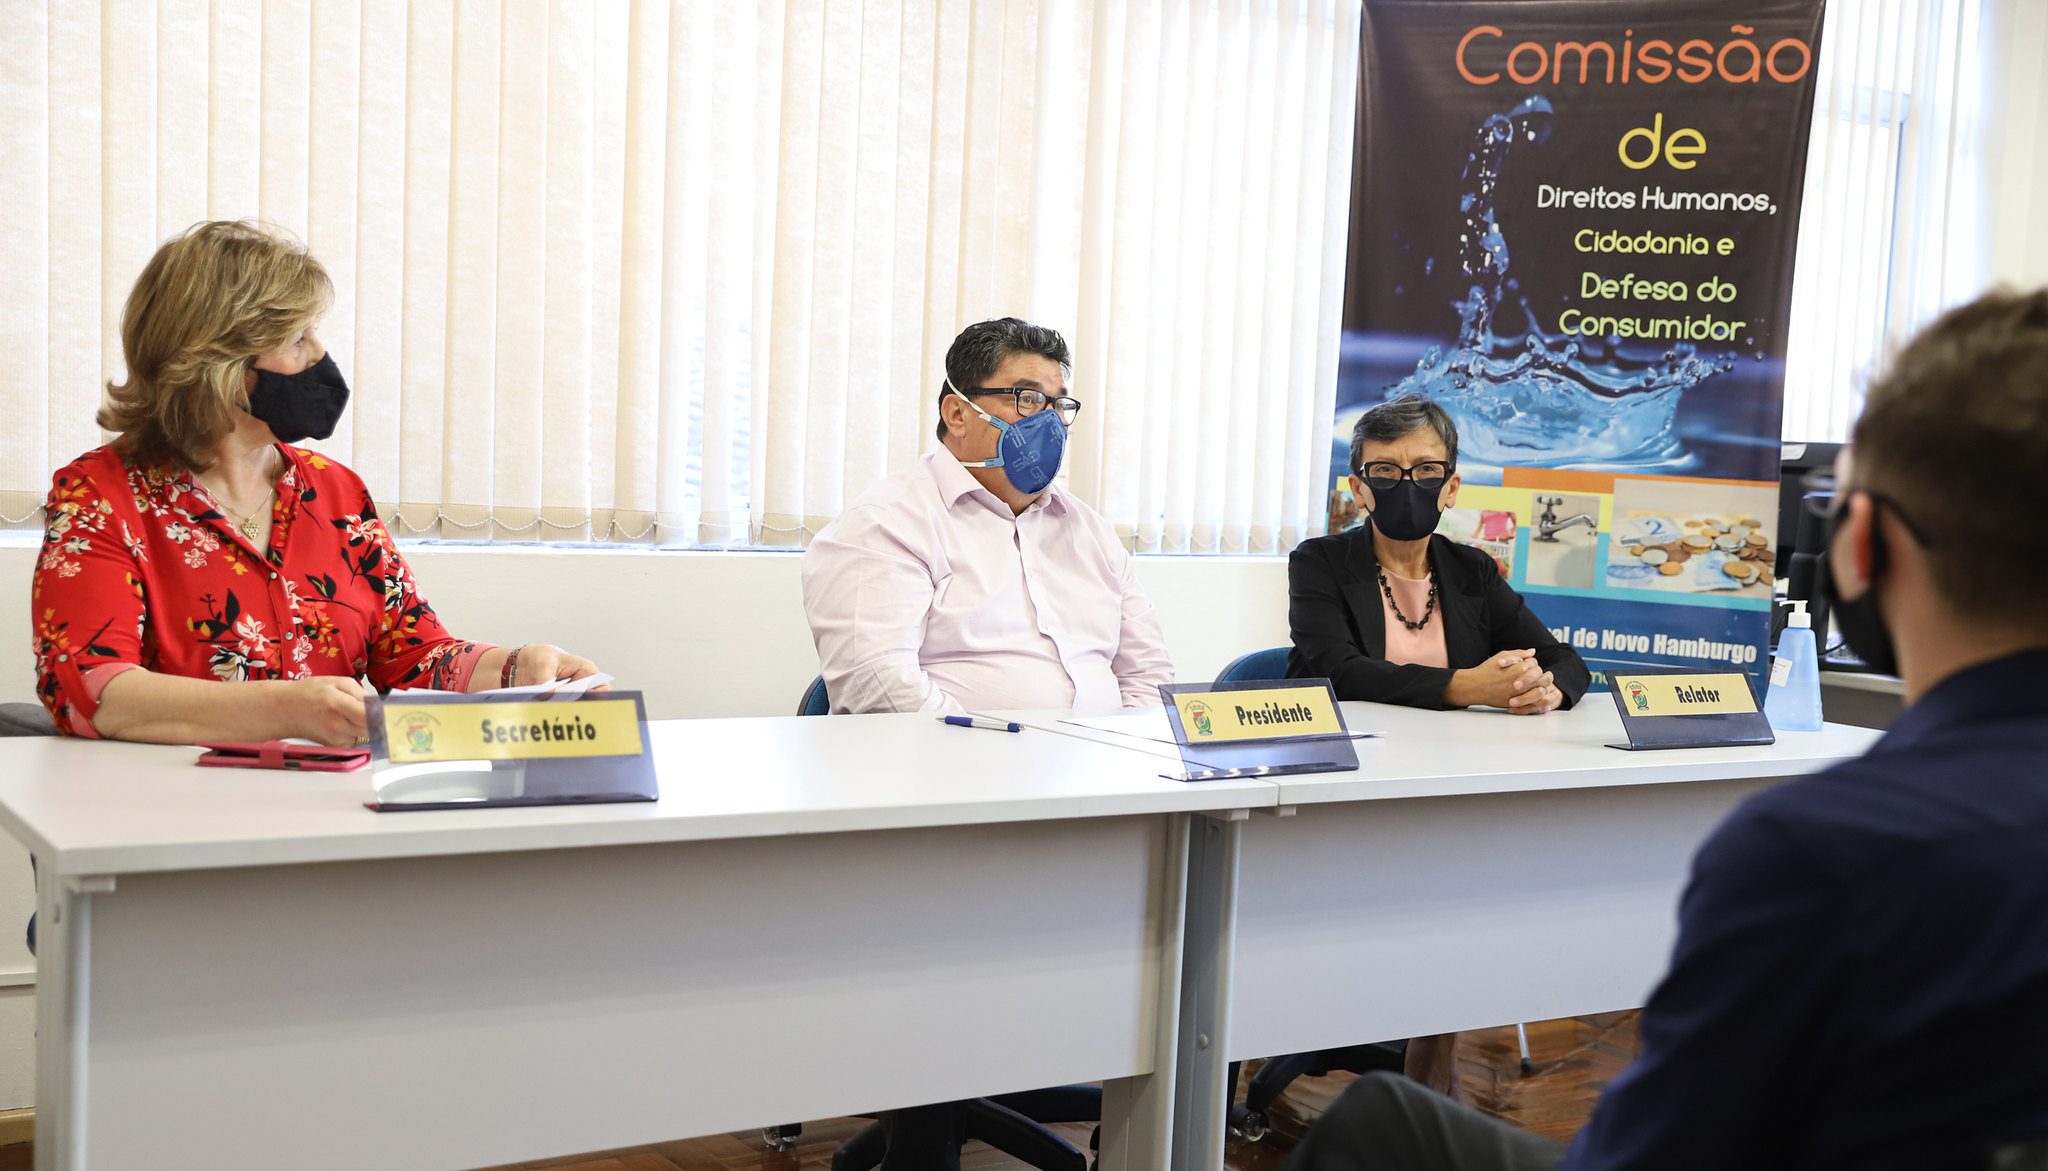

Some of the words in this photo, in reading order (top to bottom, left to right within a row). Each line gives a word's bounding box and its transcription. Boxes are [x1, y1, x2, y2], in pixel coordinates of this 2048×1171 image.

[1455, 24, 1812, 85] Comissão
[1618, 112, 1707, 170] de
[1537, 184, 1636, 210] Direitos
[1641, 186, 1777, 214] Humanos,
[1574, 229, 1709, 256] Cidadania
[1716, 236, 1735, 256] e
[1580, 272, 1688, 301] Defesa
[1696, 276, 1737, 303] do
[1559, 309, 1746, 341] Consumidor
[1573, 627, 1598, 648] de
[1601, 629, 1650, 654] Novo
[1653, 634, 1757, 664] Hamburgo
[1674, 685, 1720, 703] Relator
[481, 715, 596, 743] Secretário
[1235, 702, 1313, 726] Presidente
